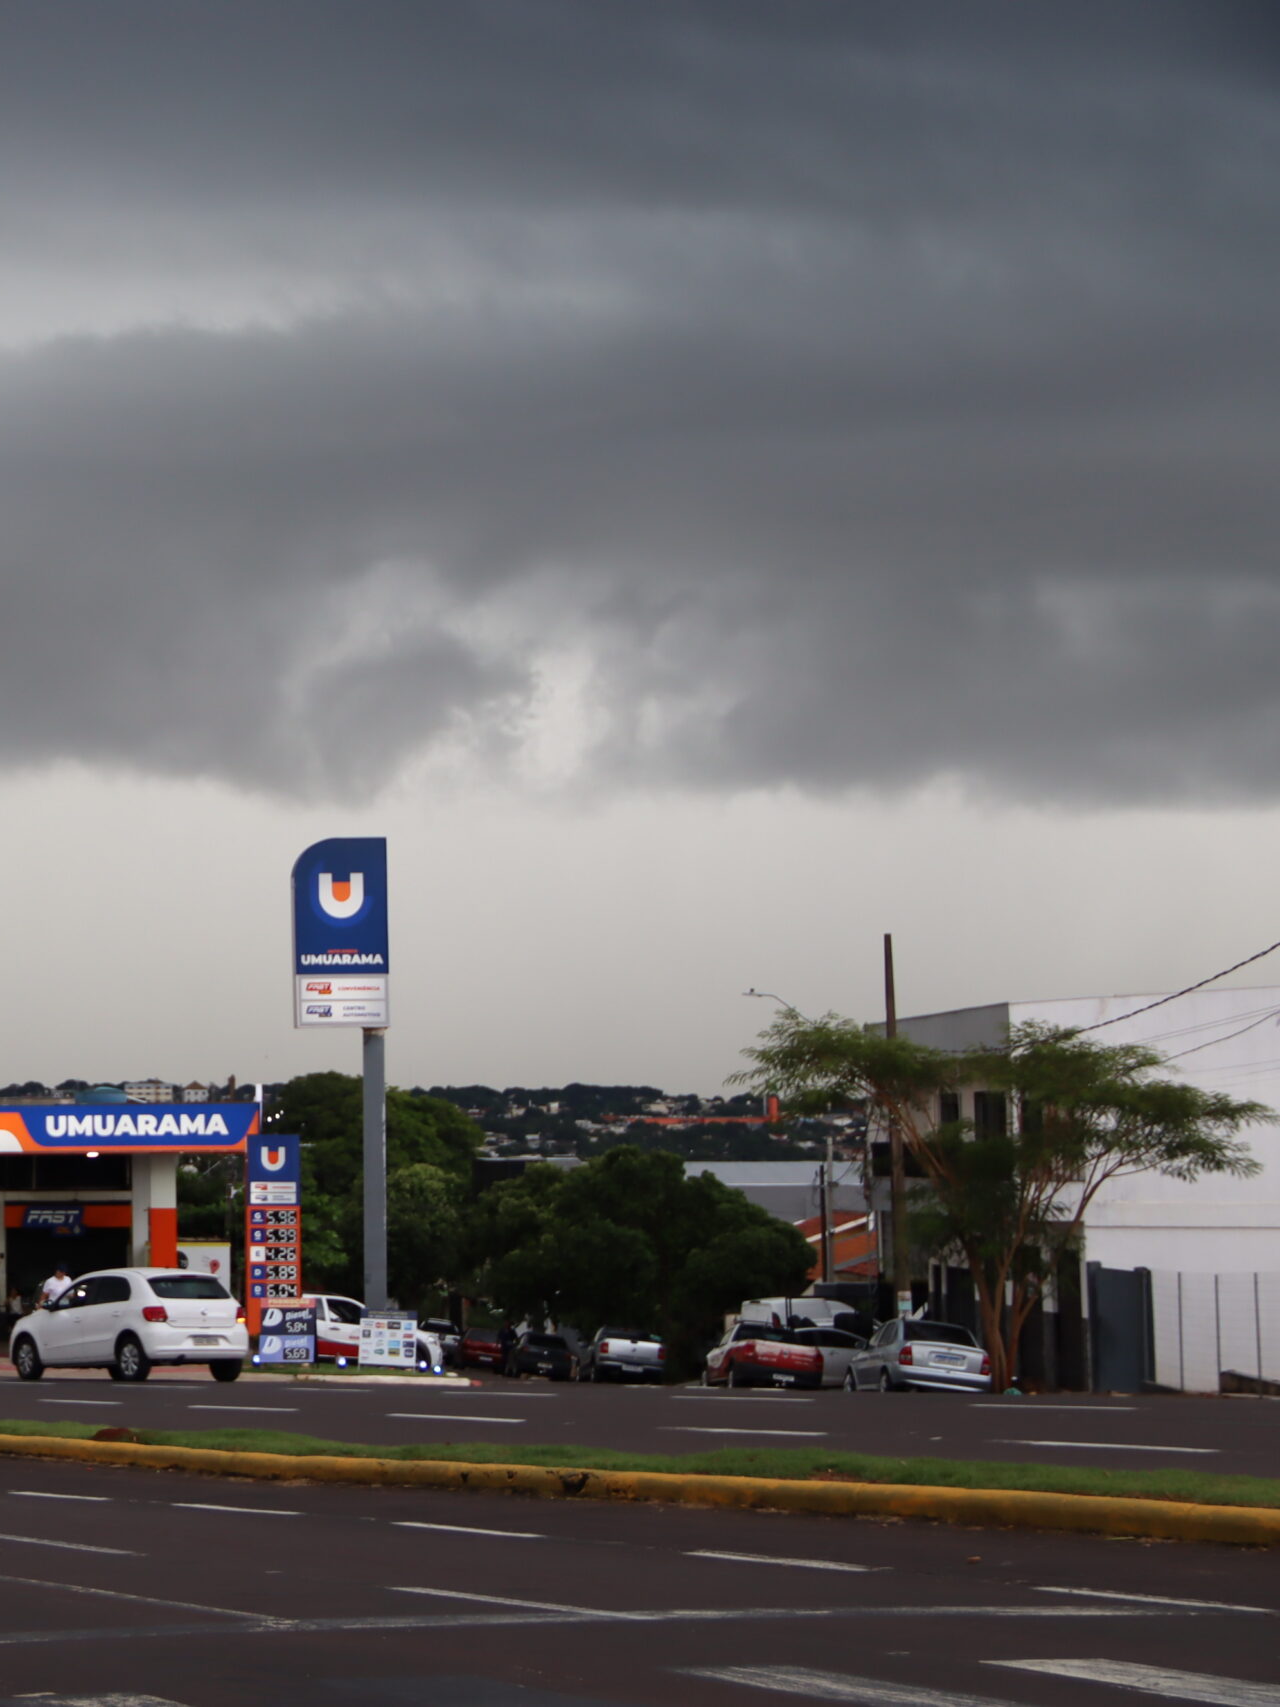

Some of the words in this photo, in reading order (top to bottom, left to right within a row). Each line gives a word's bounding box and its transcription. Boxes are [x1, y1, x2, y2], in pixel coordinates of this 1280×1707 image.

[318, 872, 364, 919] U
[301, 953, 384, 966] UMUARAMA
[45, 1113, 230, 1138] UMUARAMA
[261, 1146, 286, 1172] U
[26, 1209, 80, 1224] FAST
[266, 1210, 297, 1225] 5.96
[266, 1229, 297, 1243] 5.99
[266, 1247, 297, 1261] 4.26
[266, 1265, 297, 1280] 5.89
[266, 1283, 297, 1298] 6.04
